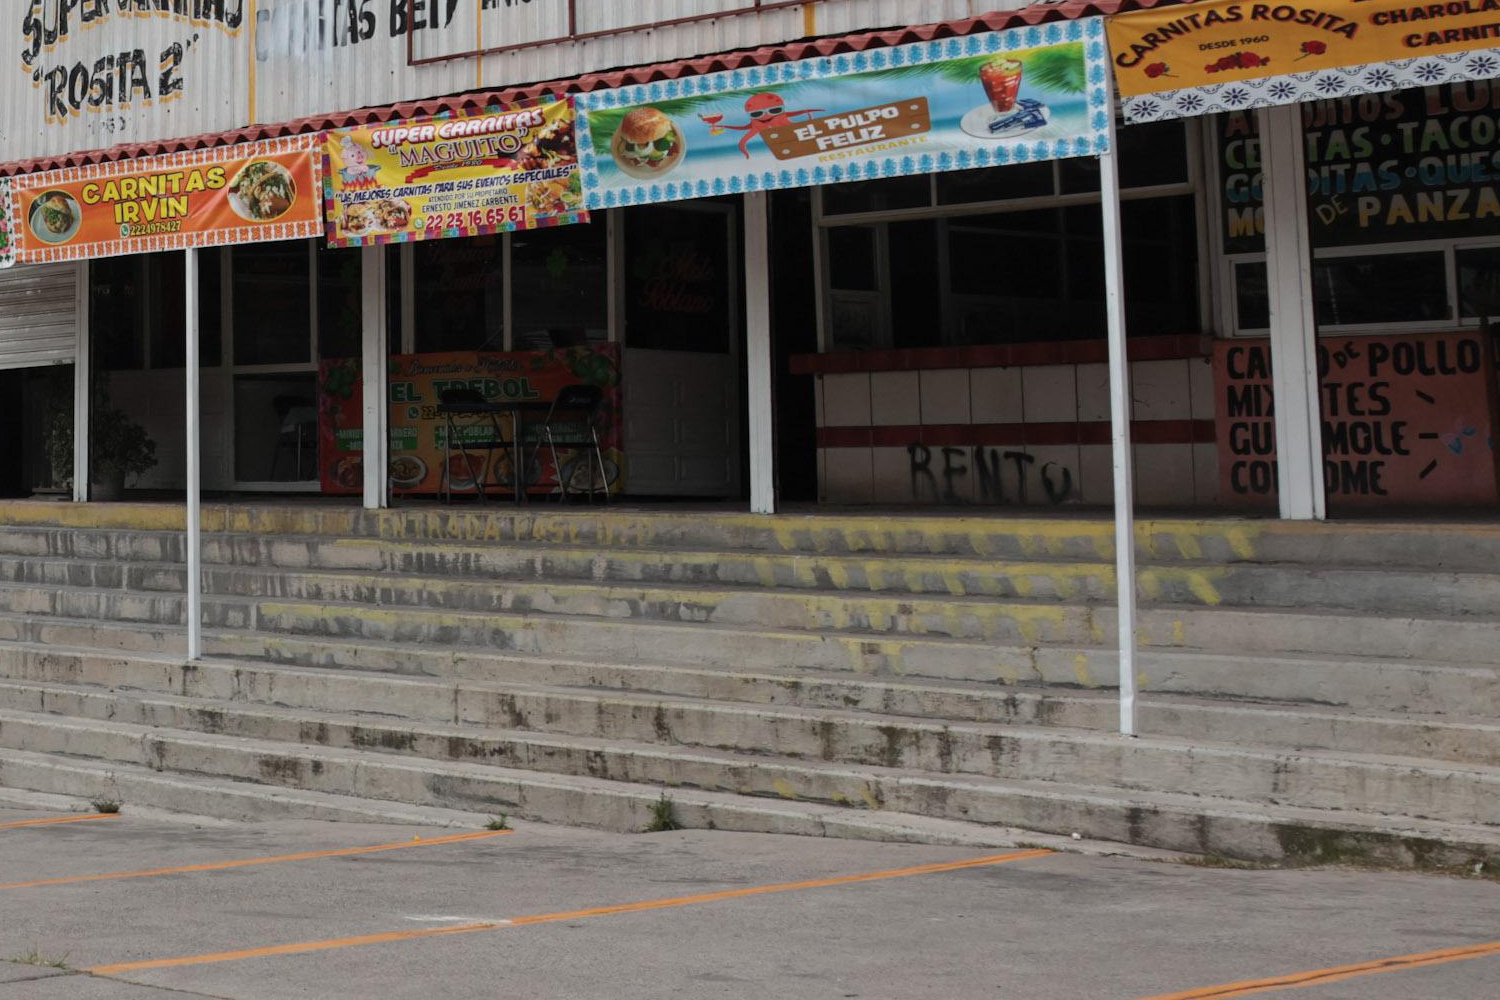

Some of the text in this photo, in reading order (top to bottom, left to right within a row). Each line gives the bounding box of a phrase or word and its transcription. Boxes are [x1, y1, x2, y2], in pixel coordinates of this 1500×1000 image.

[1115, 3, 1359, 68] CARNITAS ROSITA
[1199, 35, 1269, 51] DESDE 1960
[371, 107, 546, 149] SUPER CARNITAS
[794, 106, 899, 140] EL PULPO
[817, 123, 886, 151] FELIZ
[818, 136, 928, 163] RESTAURANTE
[1225, 115, 1500, 169] CETAS TACO
[82, 166, 226, 205] CARNITAS
[354, 188, 391, 200] MEJORES
[393, 185, 432, 198] CARNITAS
[434, 182, 455, 193] PARA
[457, 180, 473, 190] SUS
[475, 174, 511, 188] EVENTOS
[114, 195, 188, 224] IRVIN
[422, 202, 452, 213] ERNESTO
[426, 214, 443, 230] 22
[446, 212, 463, 229] 23
[468, 210, 482, 226] 16
[486, 207, 505, 224] 65
[1315, 187, 1500, 228] DE PANZA
[1367, 339, 1481, 377] POLLO
[389, 380, 423, 403] EL
